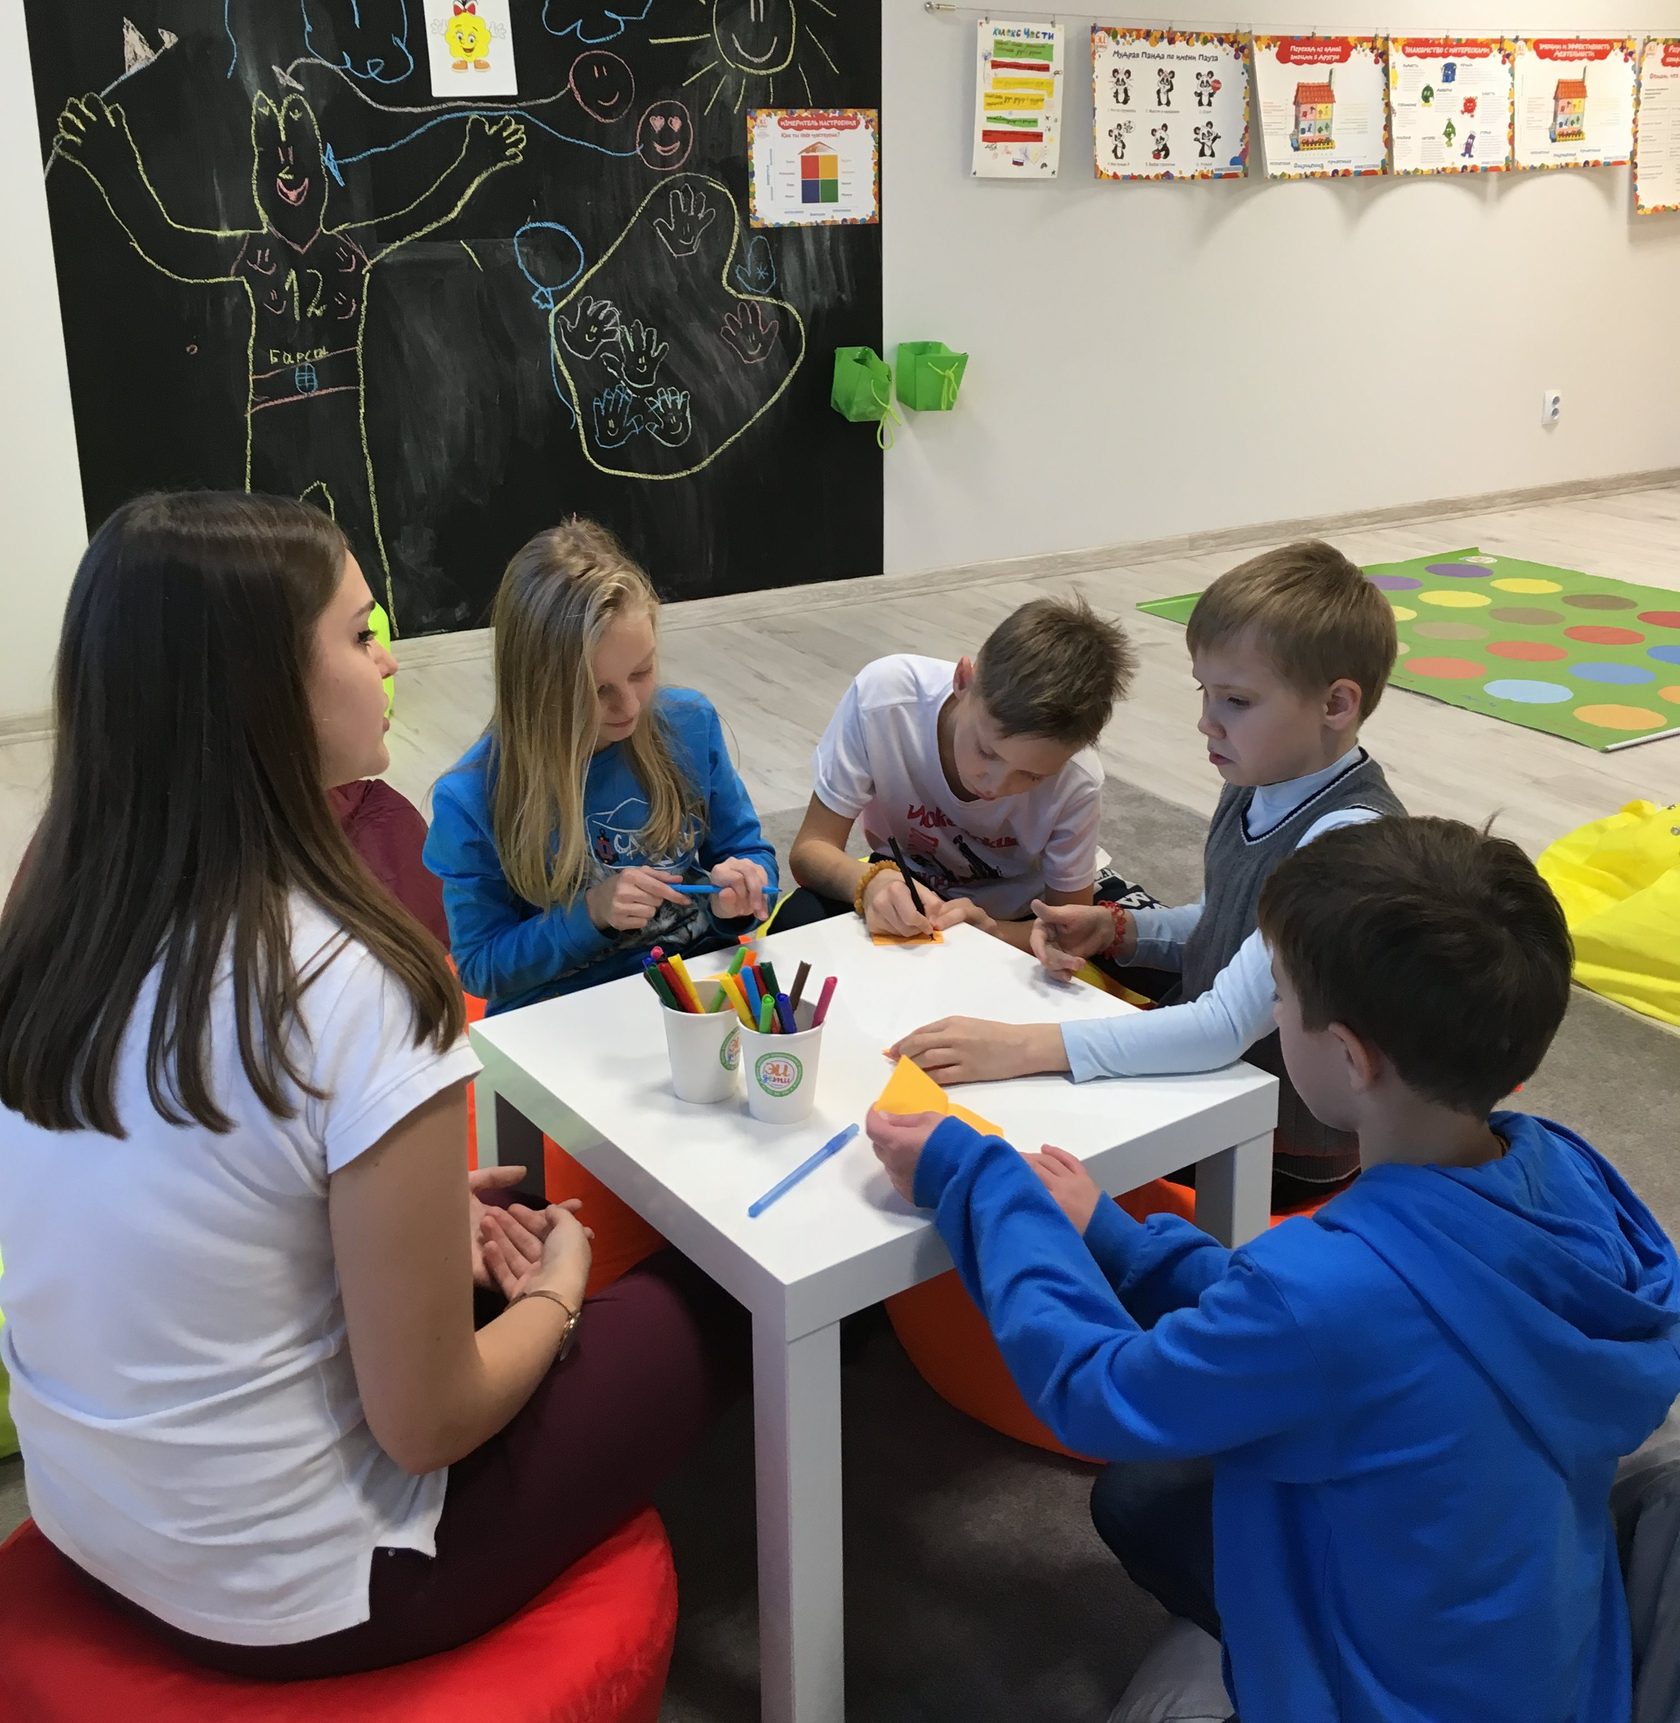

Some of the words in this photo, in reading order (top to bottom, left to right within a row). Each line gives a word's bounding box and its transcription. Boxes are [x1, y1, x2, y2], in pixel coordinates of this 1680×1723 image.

[1112, 50, 1139, 60] Мудрая
[1141, 51, 1165, 60] Панда
[1198, 53, 1219, 63] Пауза
[284, 267, 327, 321] 12
[269, 345, 329, 365] Барса
